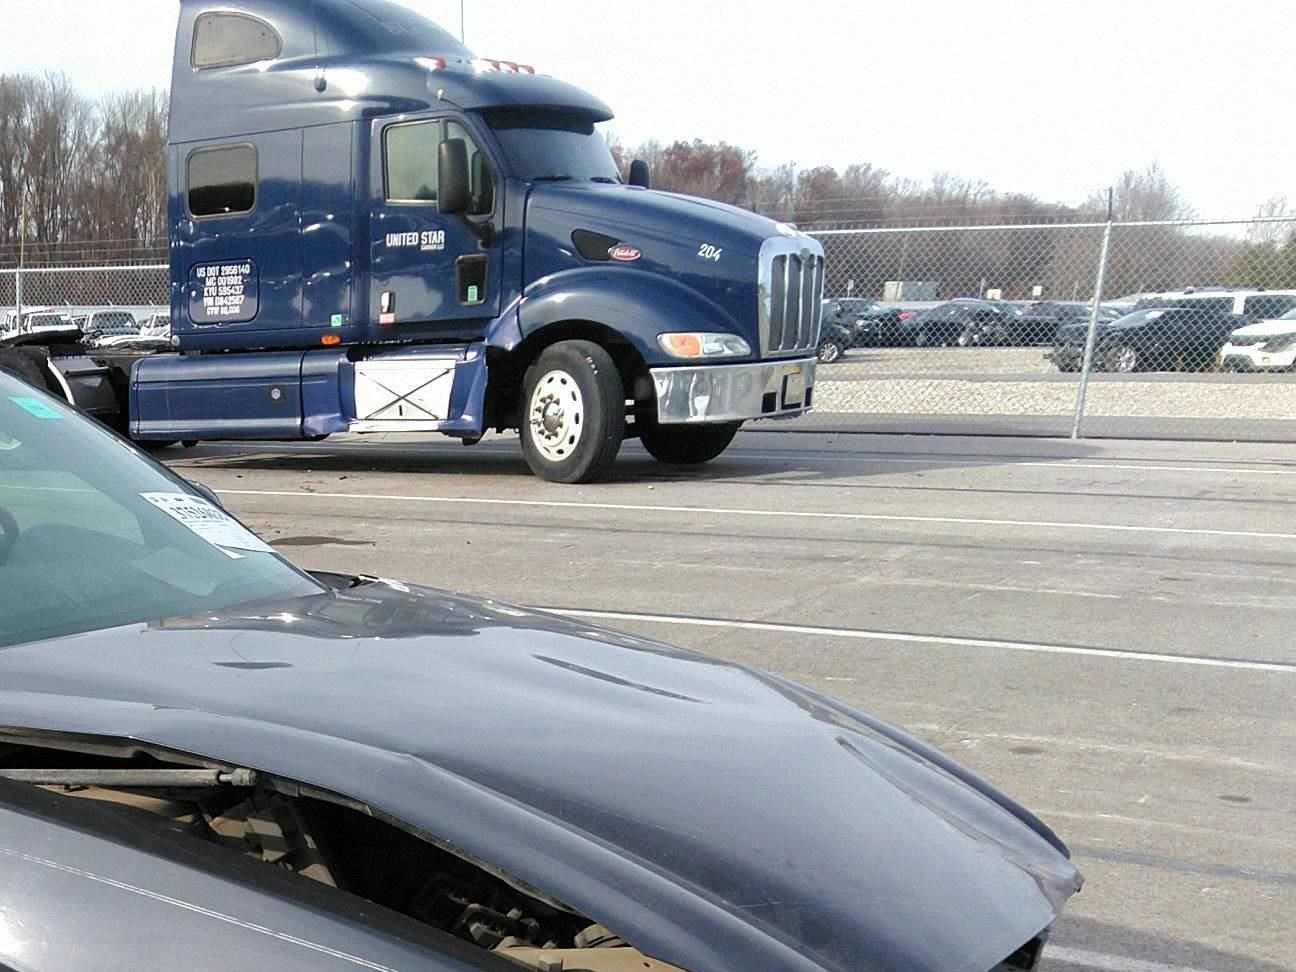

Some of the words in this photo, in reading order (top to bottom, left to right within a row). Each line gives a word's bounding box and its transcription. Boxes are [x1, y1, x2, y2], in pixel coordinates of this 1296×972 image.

[386, 232, 419, 247] UNITED
[421, 230, 445, 244] STAR
[697, 243, 722, 262] 204
[196, 267, 206, 278] US
[207, 266, 220, 277] DOT
[205, 276, 217, 287] MC
[203, 286, 217, 297] KYU
